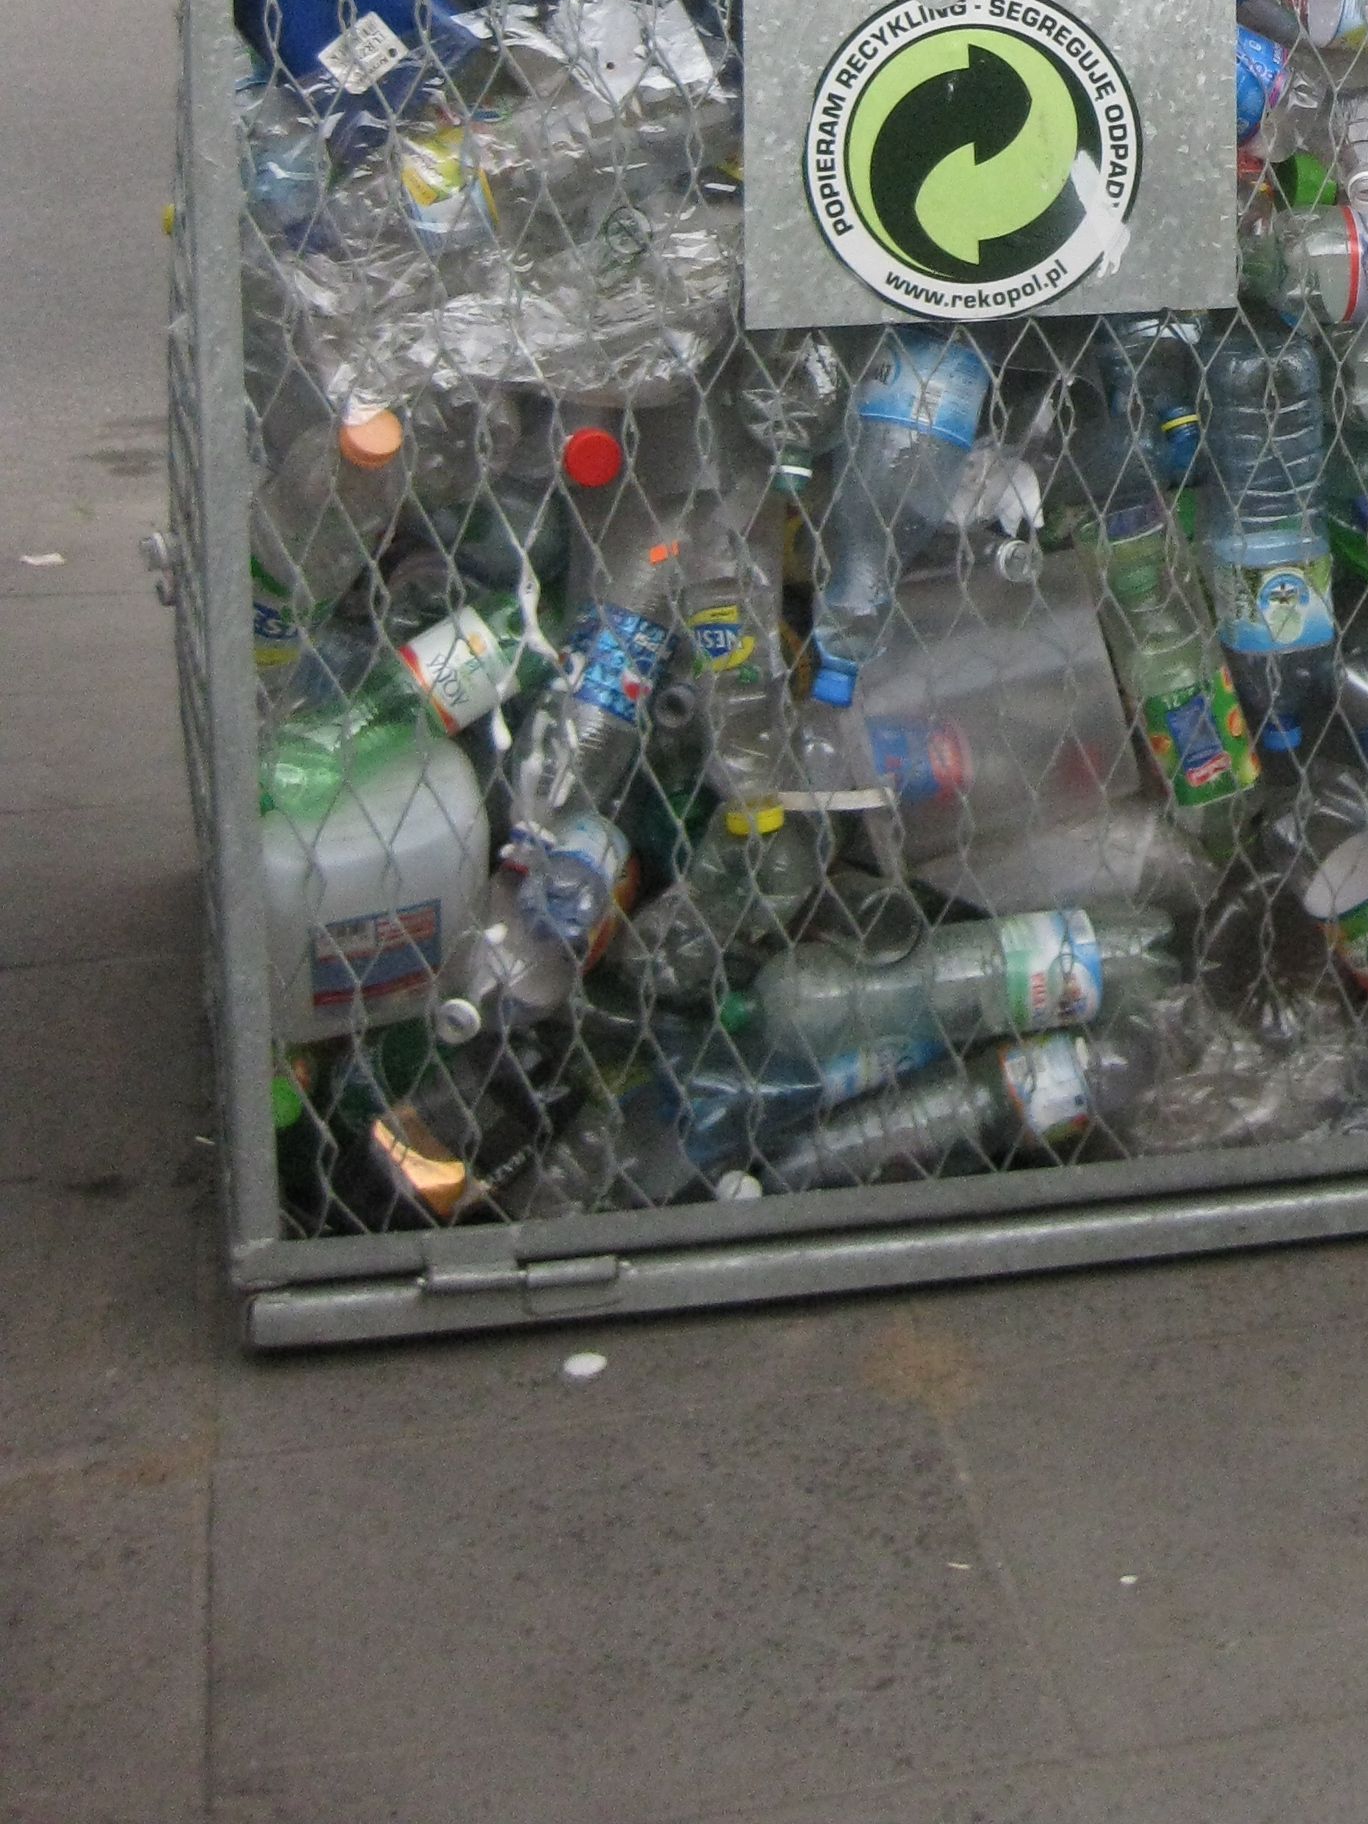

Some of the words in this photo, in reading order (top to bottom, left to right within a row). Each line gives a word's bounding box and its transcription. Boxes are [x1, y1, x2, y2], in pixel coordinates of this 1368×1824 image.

[815, 94, 854, 237] POPIERAM
[840, 1, 968, 94] RECYKLING
[1105, 103, 1131, 210] ODPAD
[884, 258, 1070, 311] www.rekopol.pl
